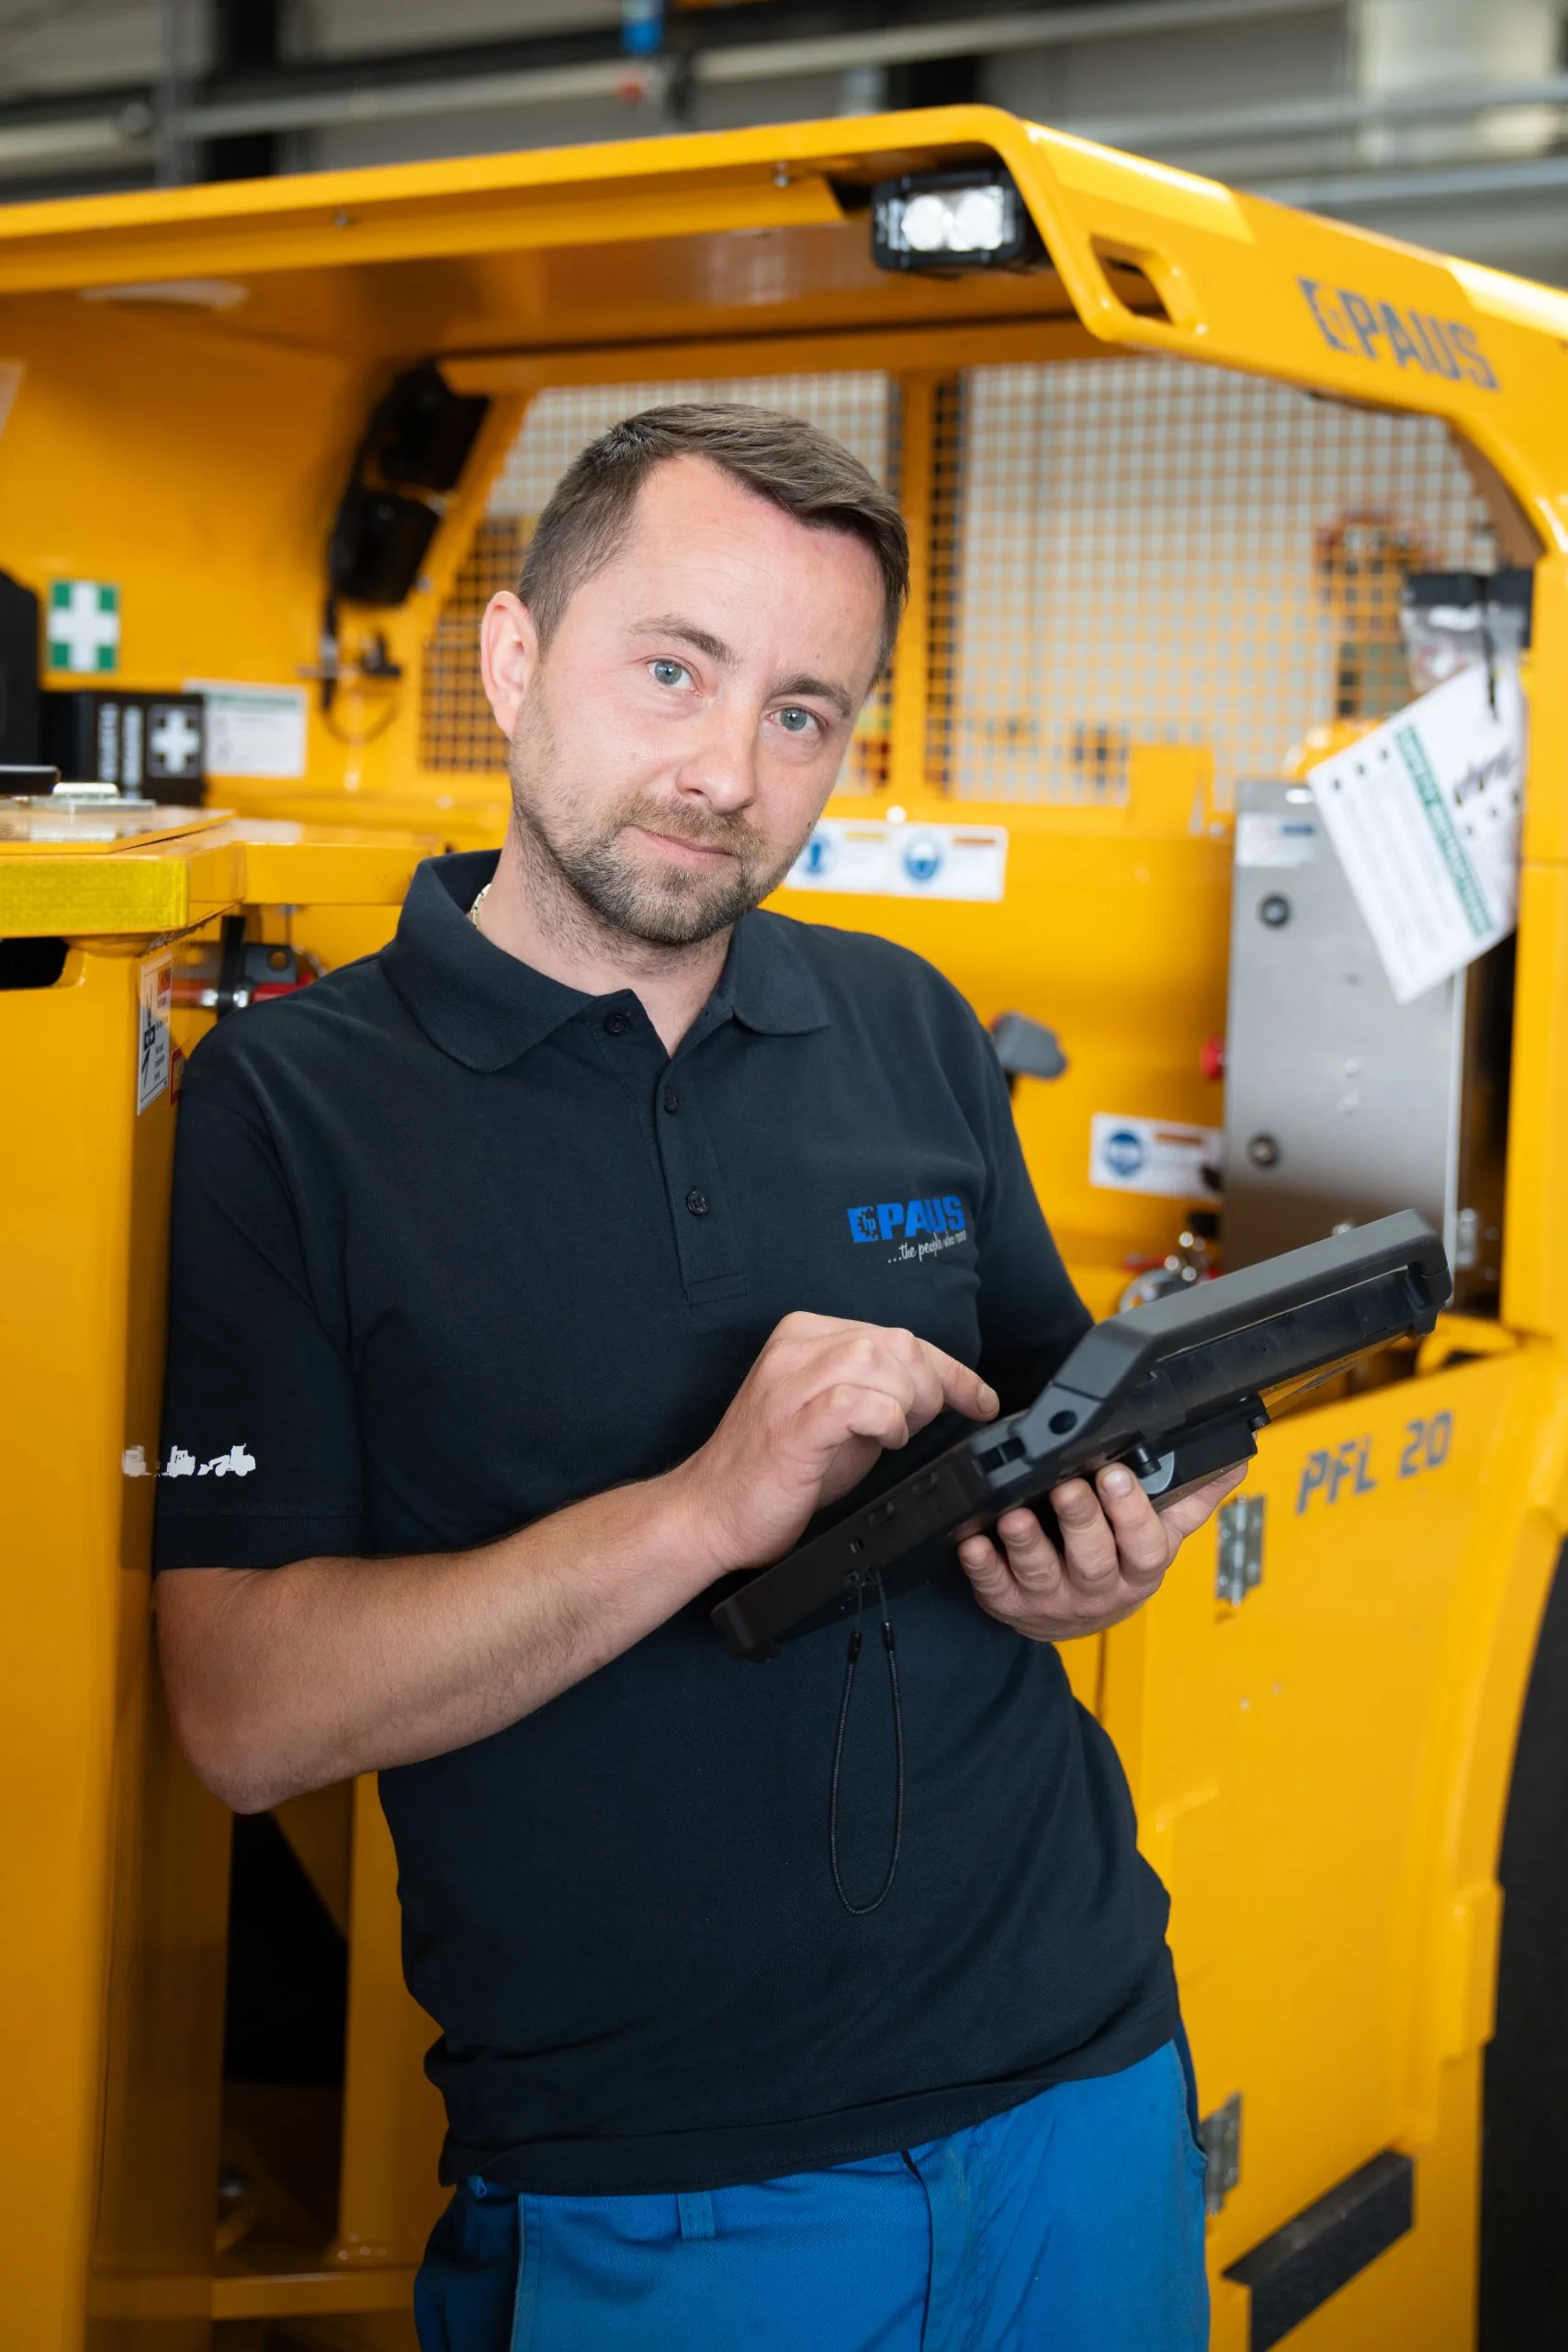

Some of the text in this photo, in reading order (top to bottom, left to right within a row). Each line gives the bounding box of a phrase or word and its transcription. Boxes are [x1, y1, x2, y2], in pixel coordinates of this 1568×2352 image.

[1337, 289, 1499, 392] PAUS
[876, 1195, 965, 1240] PAUS
[1296, 1409, 1452, 1514] PFL 20
